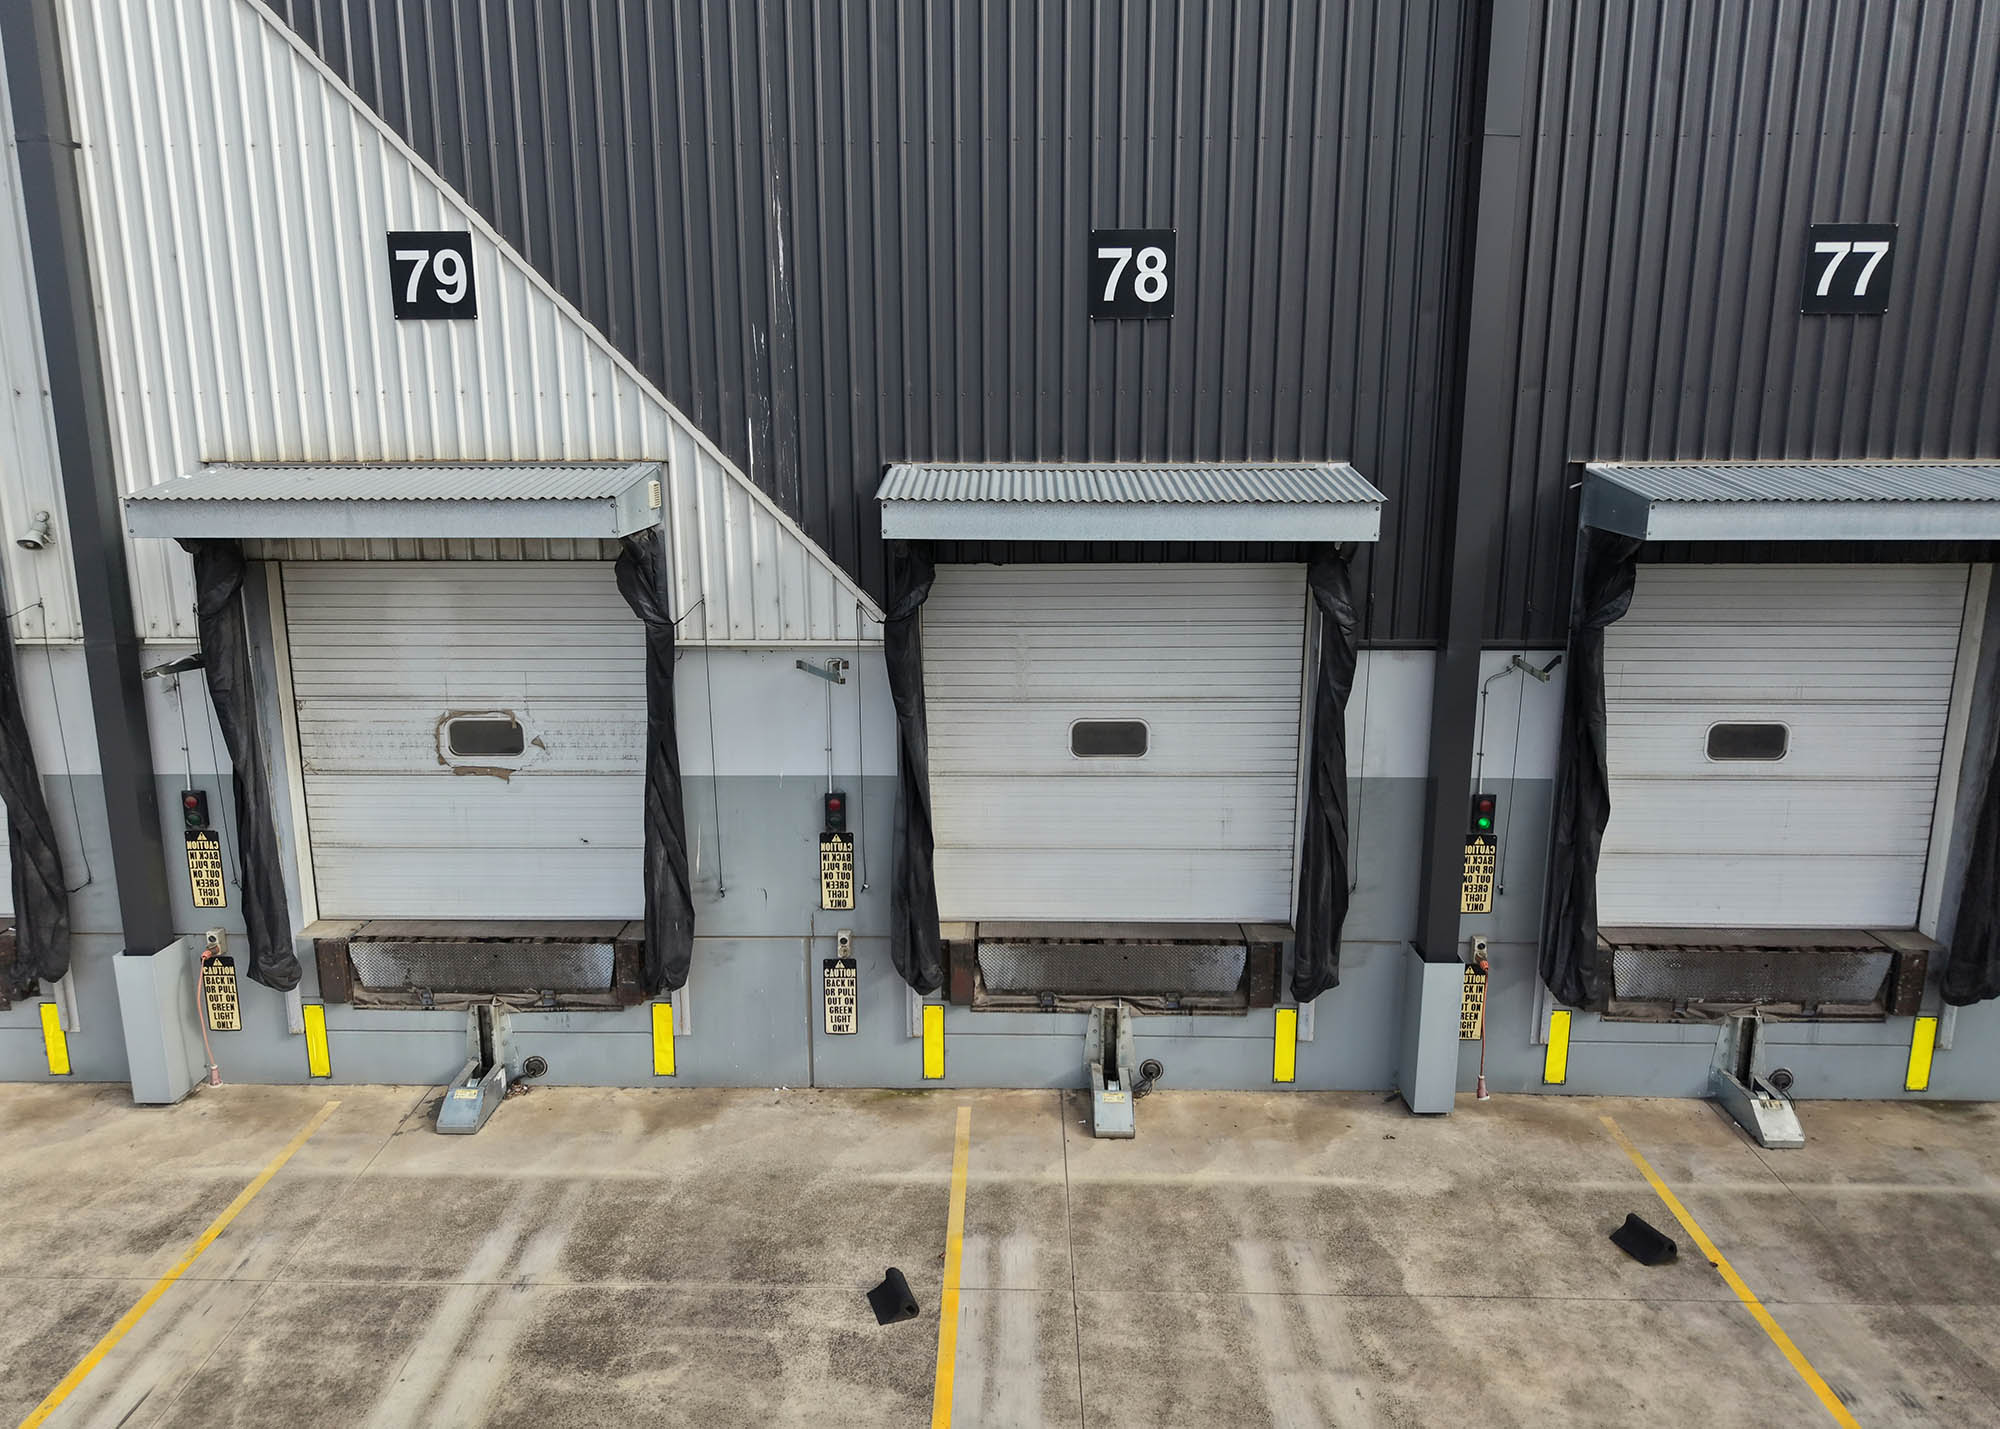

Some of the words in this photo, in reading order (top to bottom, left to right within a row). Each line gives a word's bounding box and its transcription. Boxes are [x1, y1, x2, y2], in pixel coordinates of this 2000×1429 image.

[1814, 242, 1889, 296] 77
[395, 249, 468, 304] 79
[1097, 247, 1168, 302] 78
[203, 966, 235, 975] CAUTION
[824, 968, 856, 977] CAUTION
[826, 979, 845, 987] BACK
[848, 979, 854, 987] IN
[1464, 974, 1486, 983] UTION
[1465, 994, 1483, 1002] PULL
